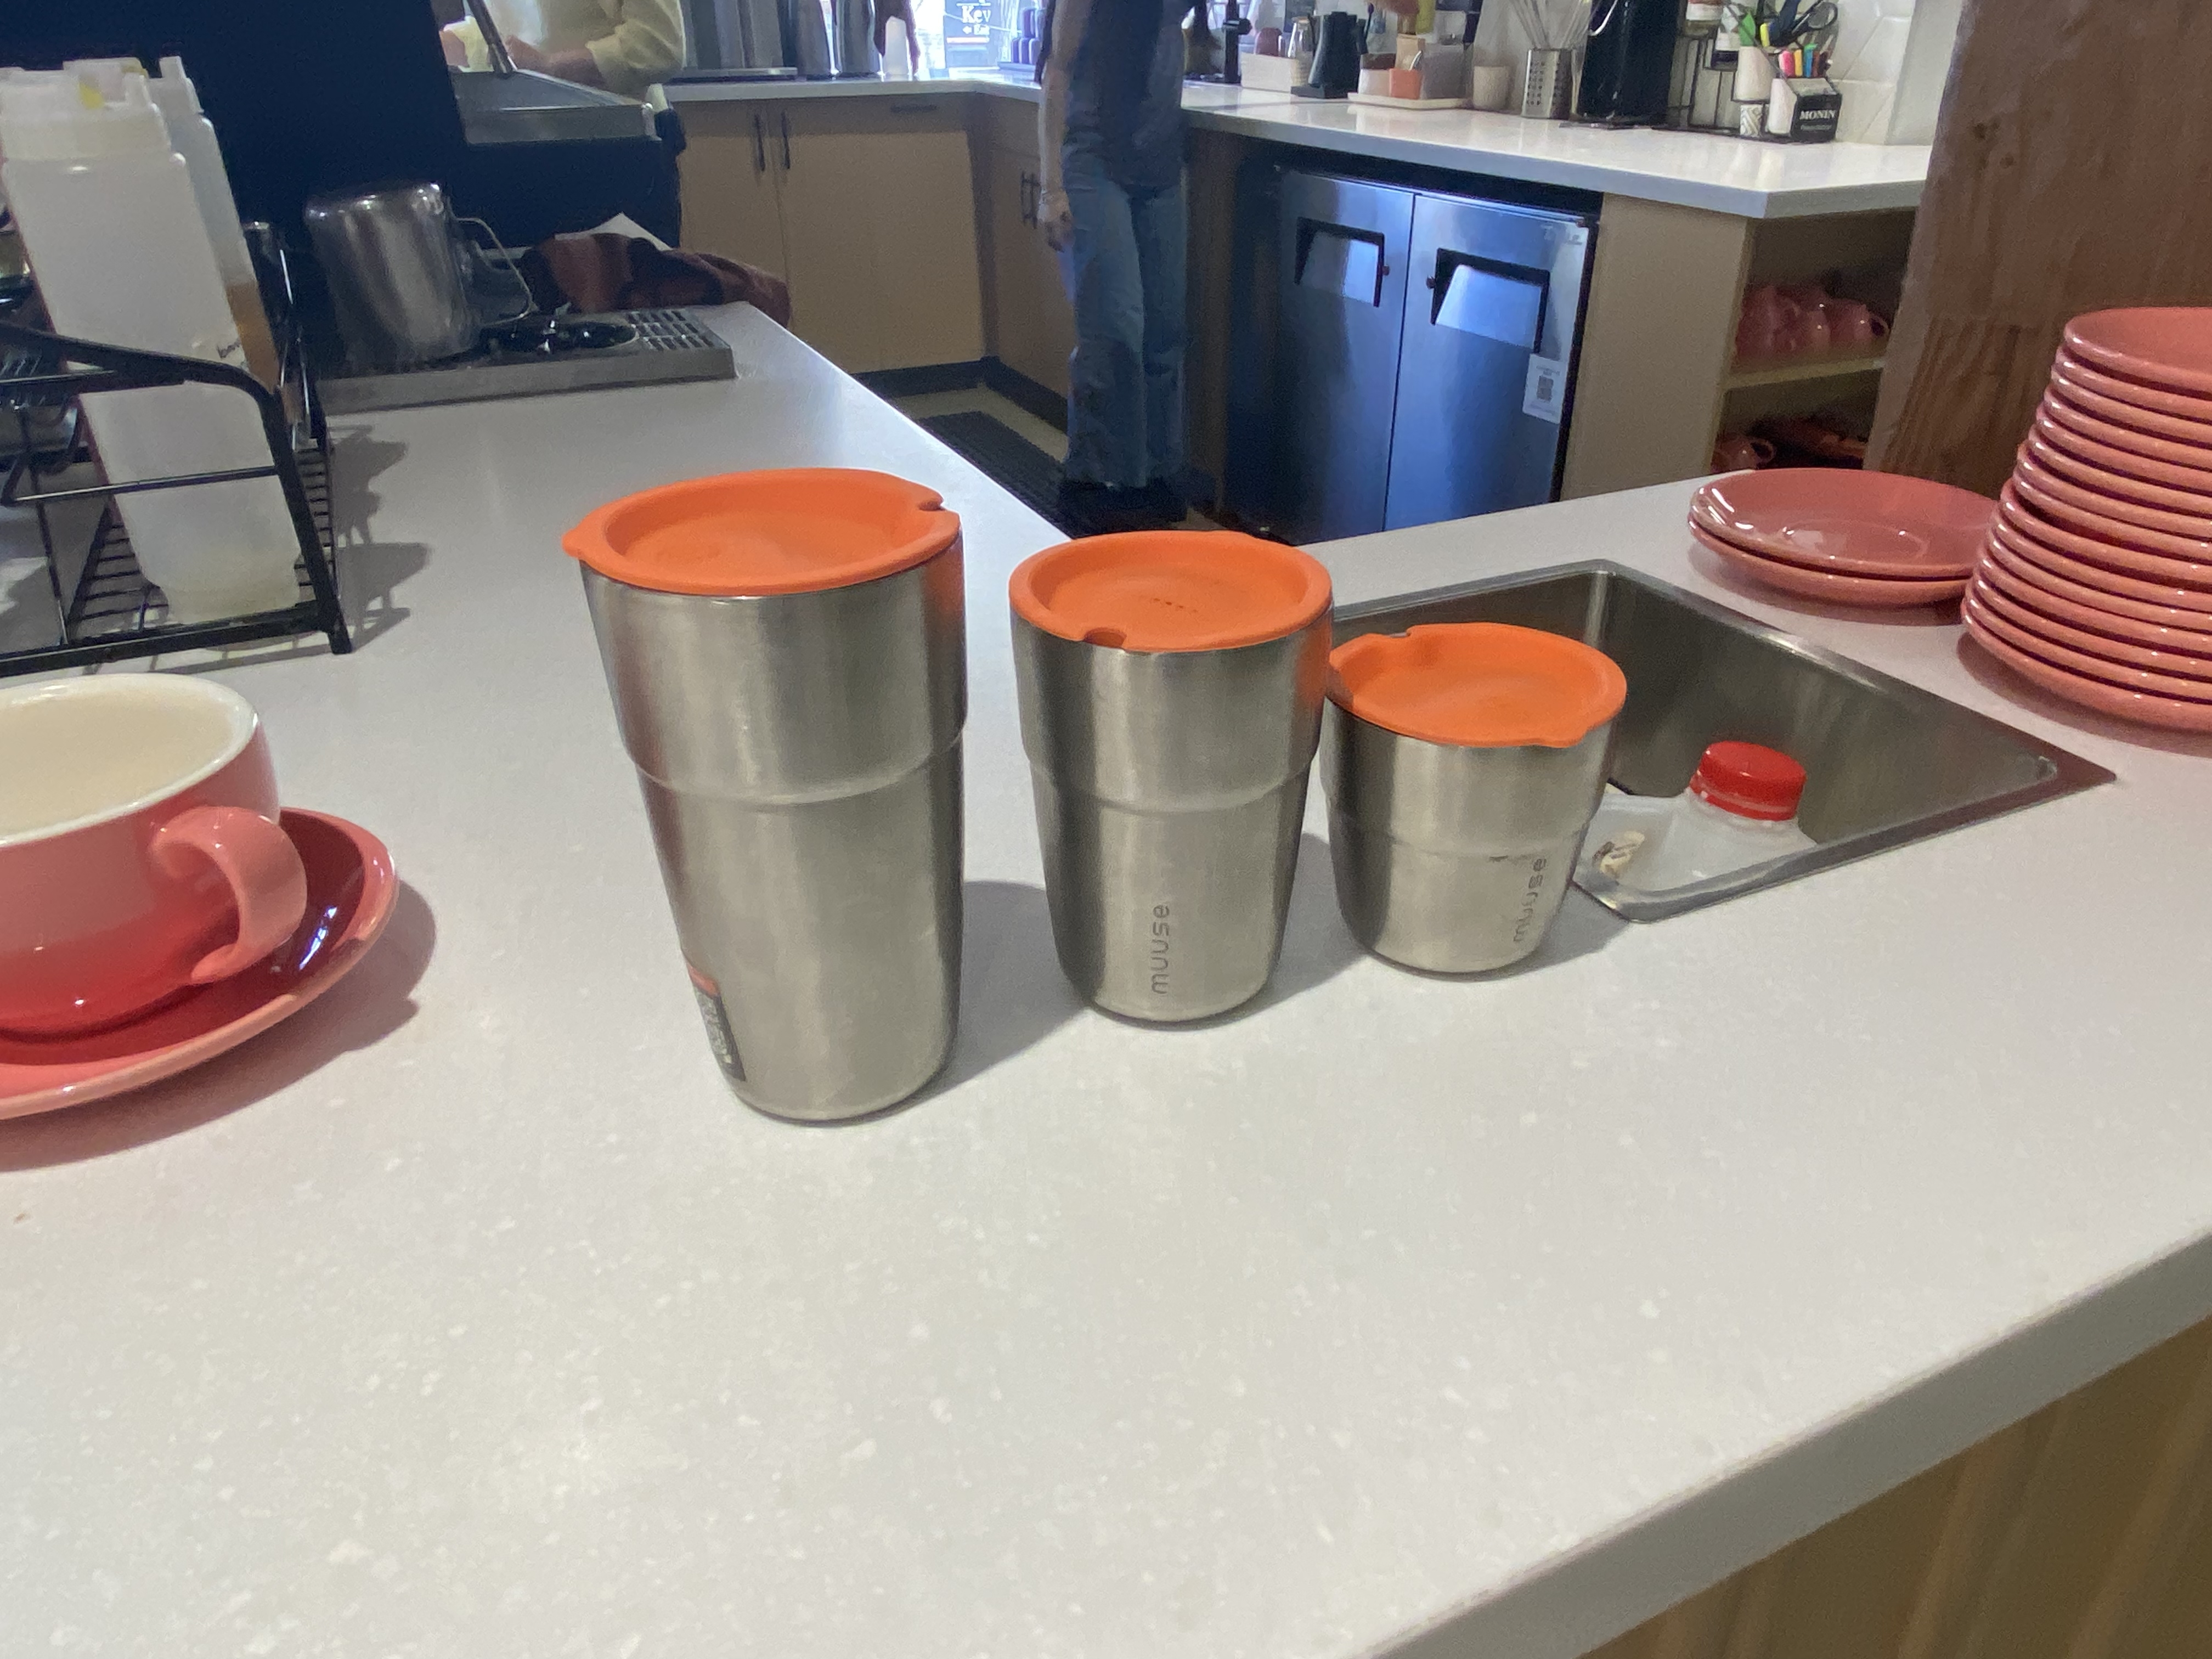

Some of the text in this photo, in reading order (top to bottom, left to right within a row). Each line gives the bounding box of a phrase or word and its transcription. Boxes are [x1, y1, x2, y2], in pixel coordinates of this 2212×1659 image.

[1799, 110, 1835, 120] MONIN
[1513, 859, 1547, 942] muuse
[1152, 905, 1170, 994] muuse
